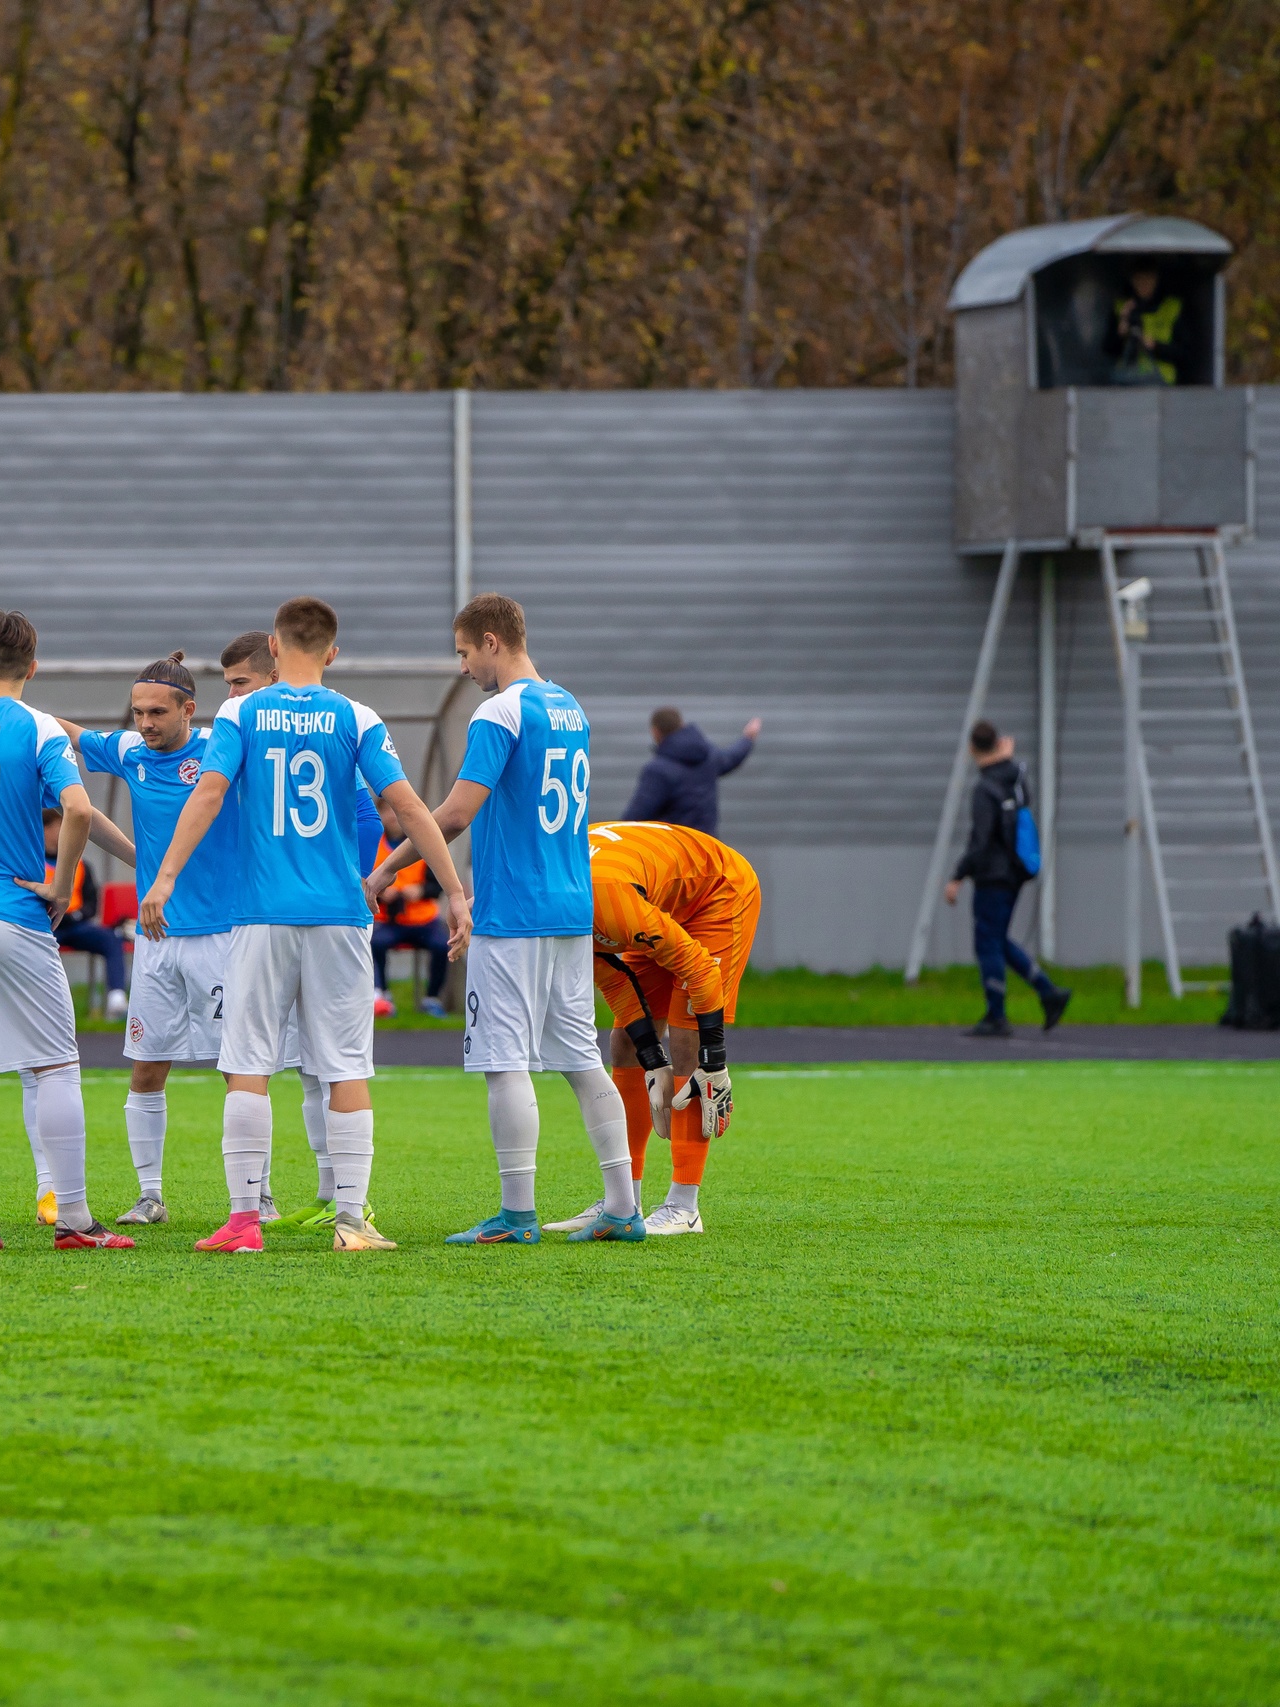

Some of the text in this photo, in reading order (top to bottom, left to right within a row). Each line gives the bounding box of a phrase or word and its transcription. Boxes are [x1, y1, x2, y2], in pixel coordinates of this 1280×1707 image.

[255, 708, 336, 736] ЛЮБЧЕНКО
[546, 708, 584, 732] БУРКОВ
[264, 747, 329, 838] 13
[538, 748, 591, 835] 59
